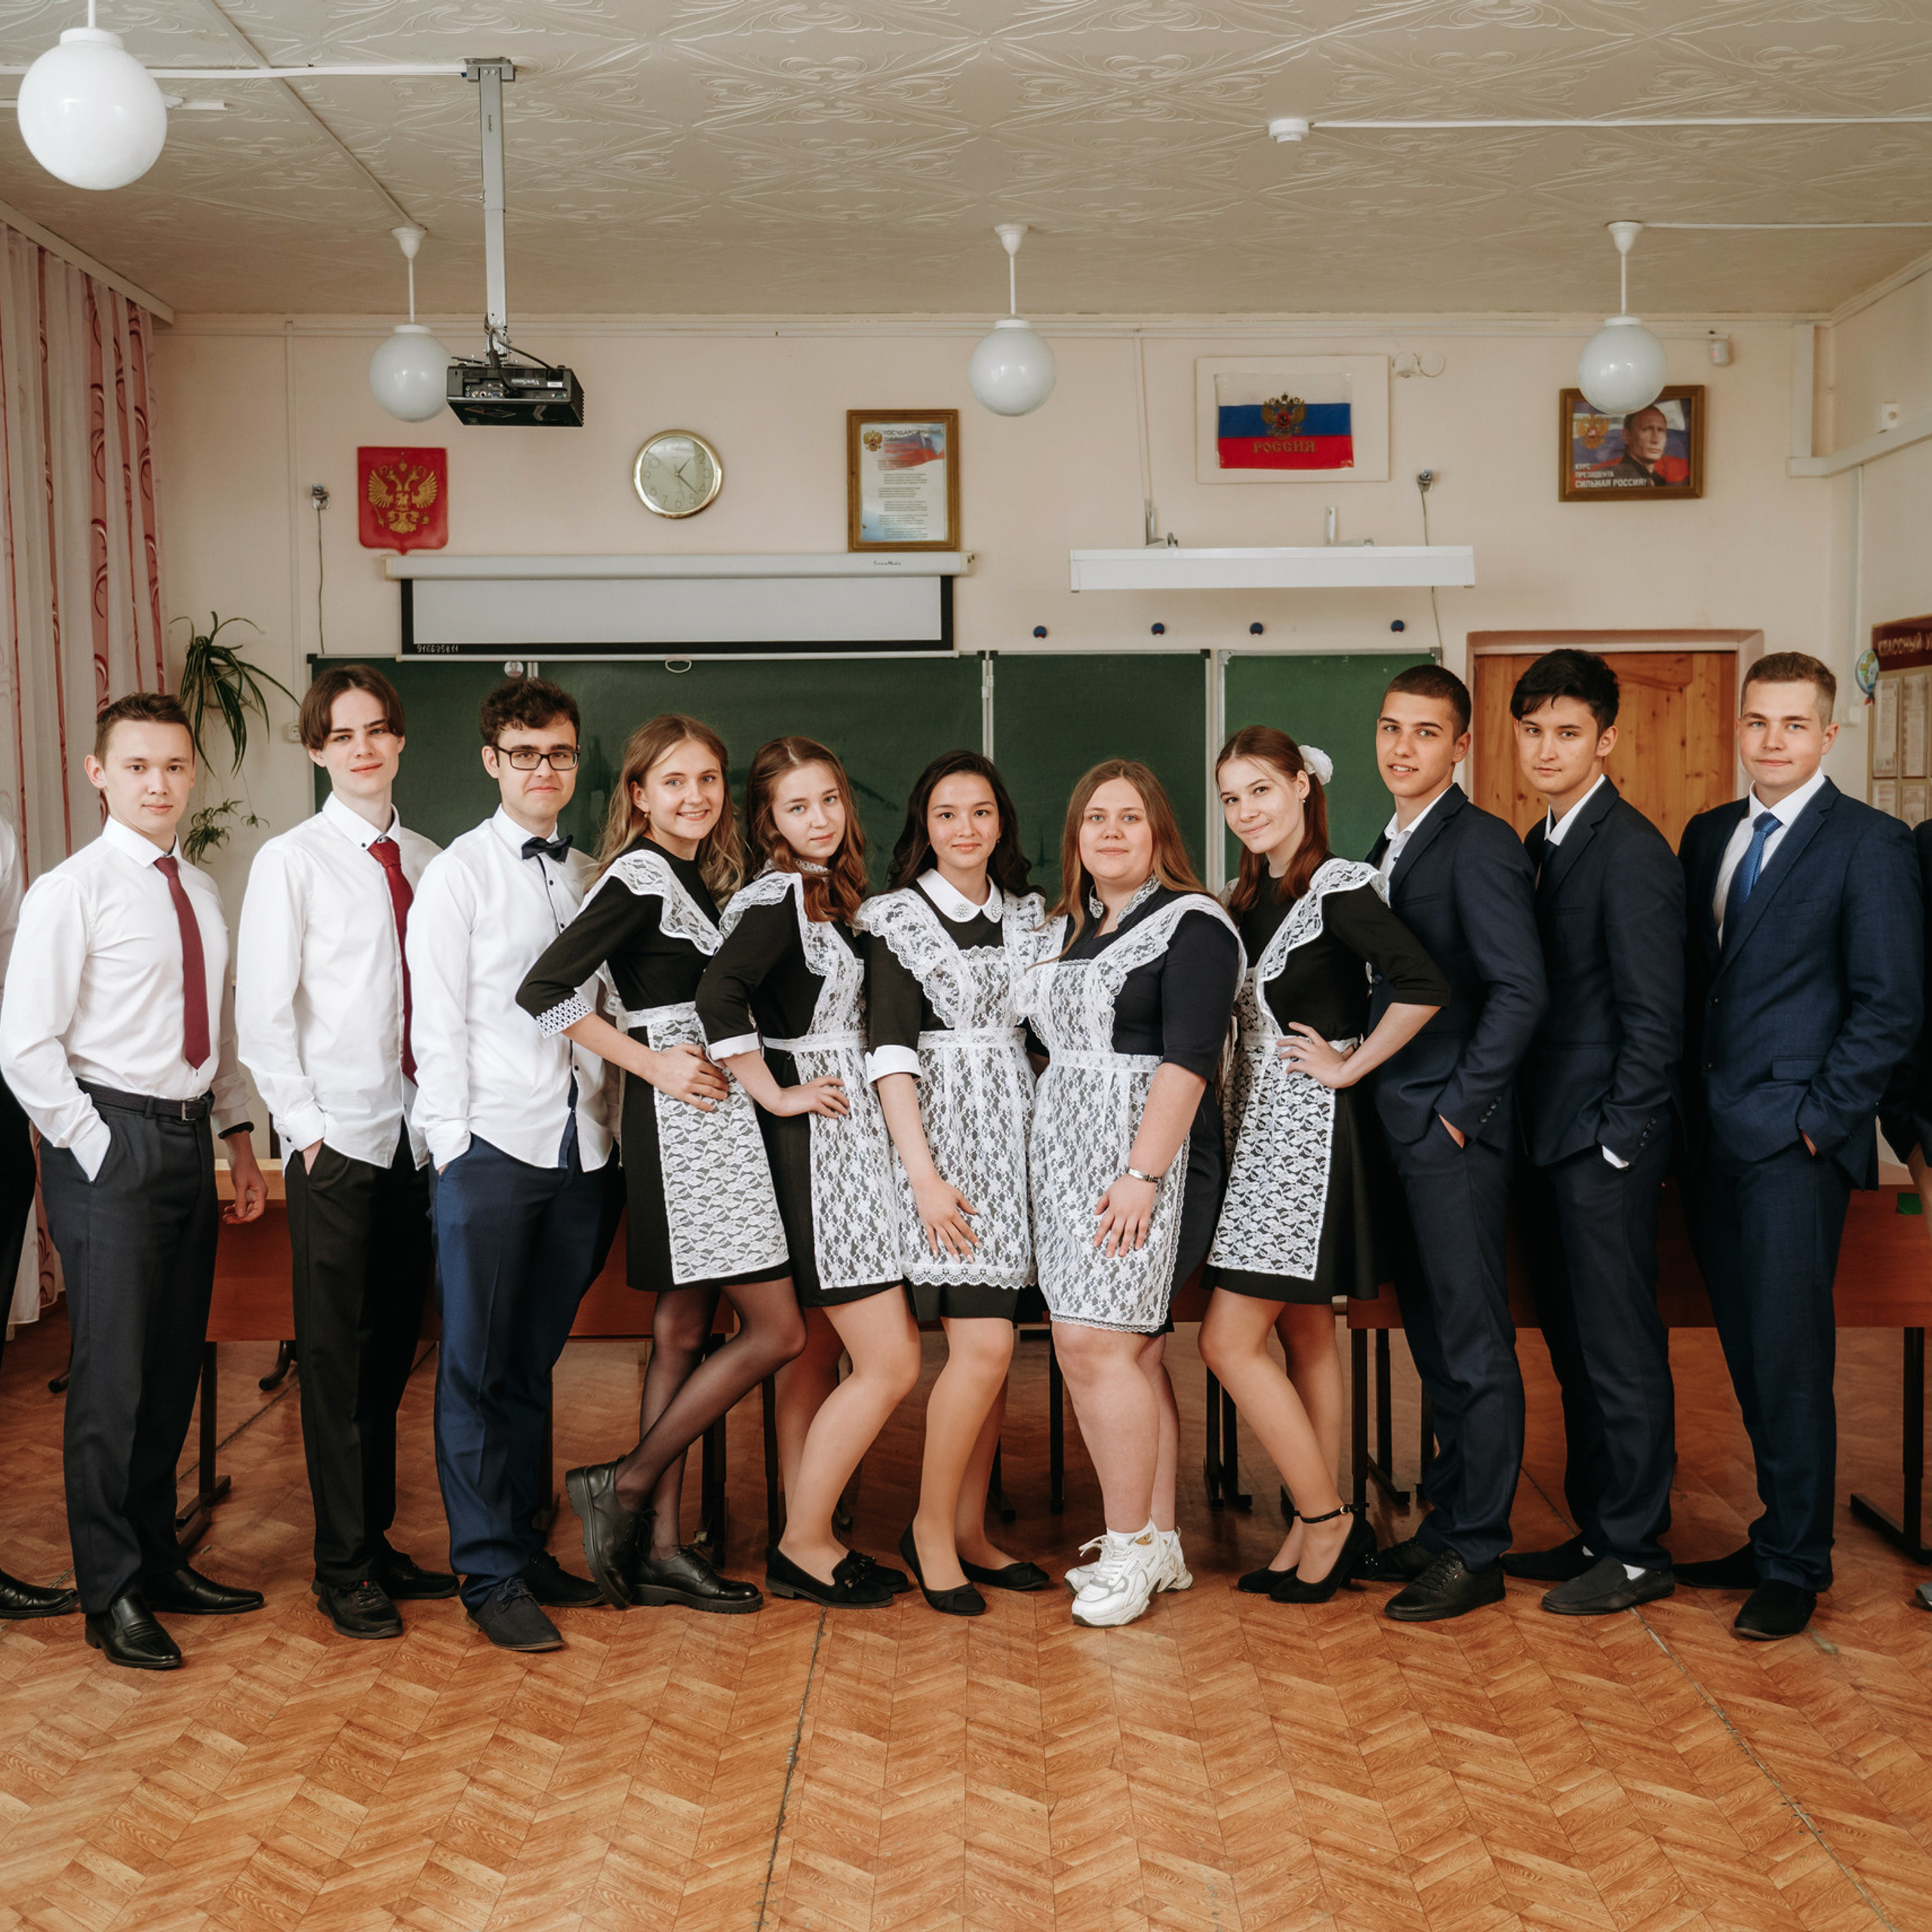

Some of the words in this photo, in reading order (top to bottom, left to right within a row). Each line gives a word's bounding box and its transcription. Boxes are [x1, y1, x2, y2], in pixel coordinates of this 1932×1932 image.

[1254, 441, 1316, 454] РОССИЯ
[1574, 479, 1611, 488] СИЛЬНАЯ
[1613, 478, 1647, 487] РОССИЯ!
[1878, 632, 1921, 657] КЛАССНЫЙ
